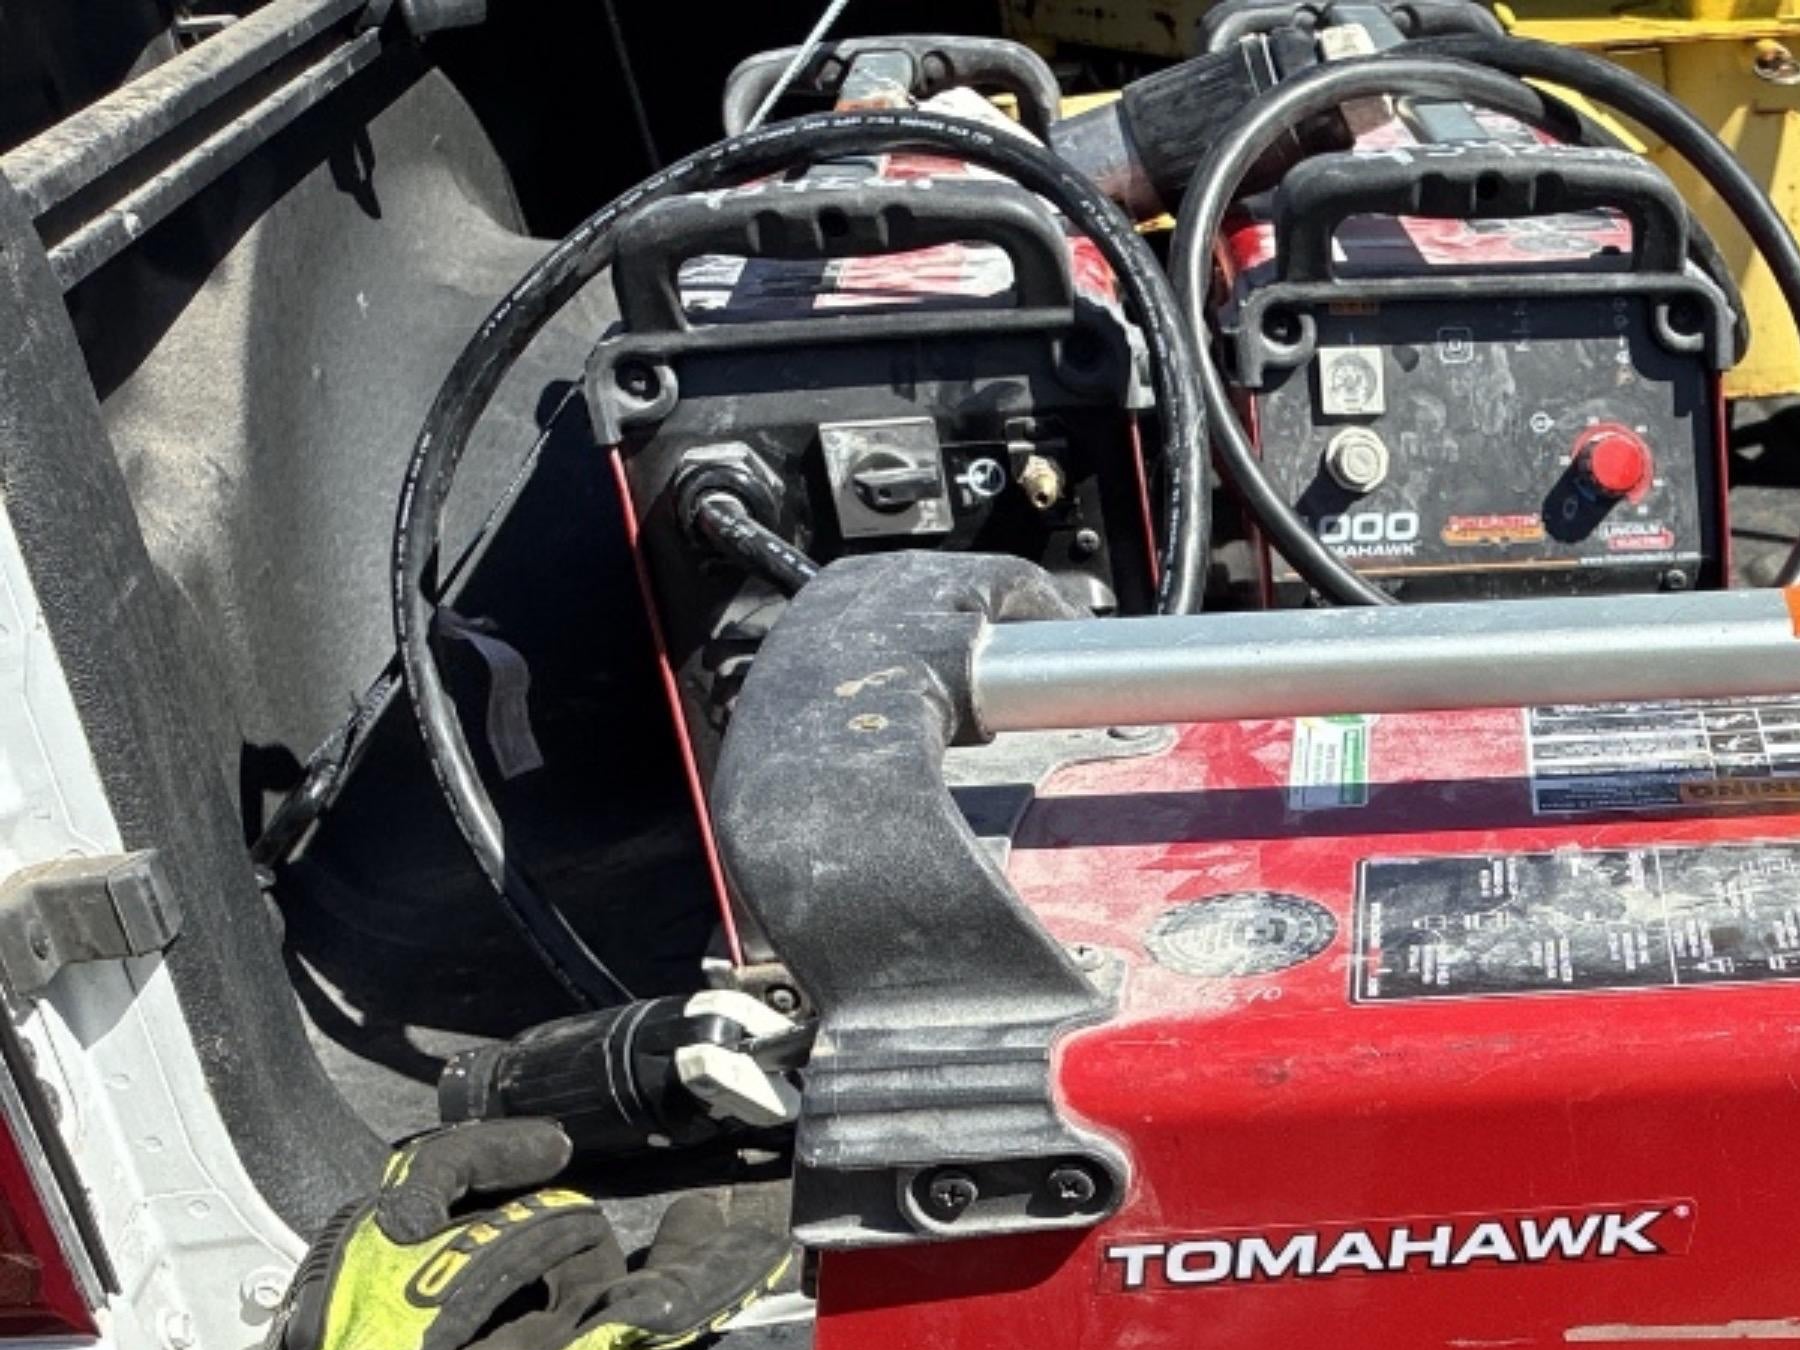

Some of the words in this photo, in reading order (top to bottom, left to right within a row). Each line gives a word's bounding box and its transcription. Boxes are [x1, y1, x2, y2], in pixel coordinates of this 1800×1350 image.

[1302, 512, 1420, 544] 000
[1329, 541, 1417, 558] MAHAWK
[1109, 1209, 1668, 1288] TOMAHAWK
